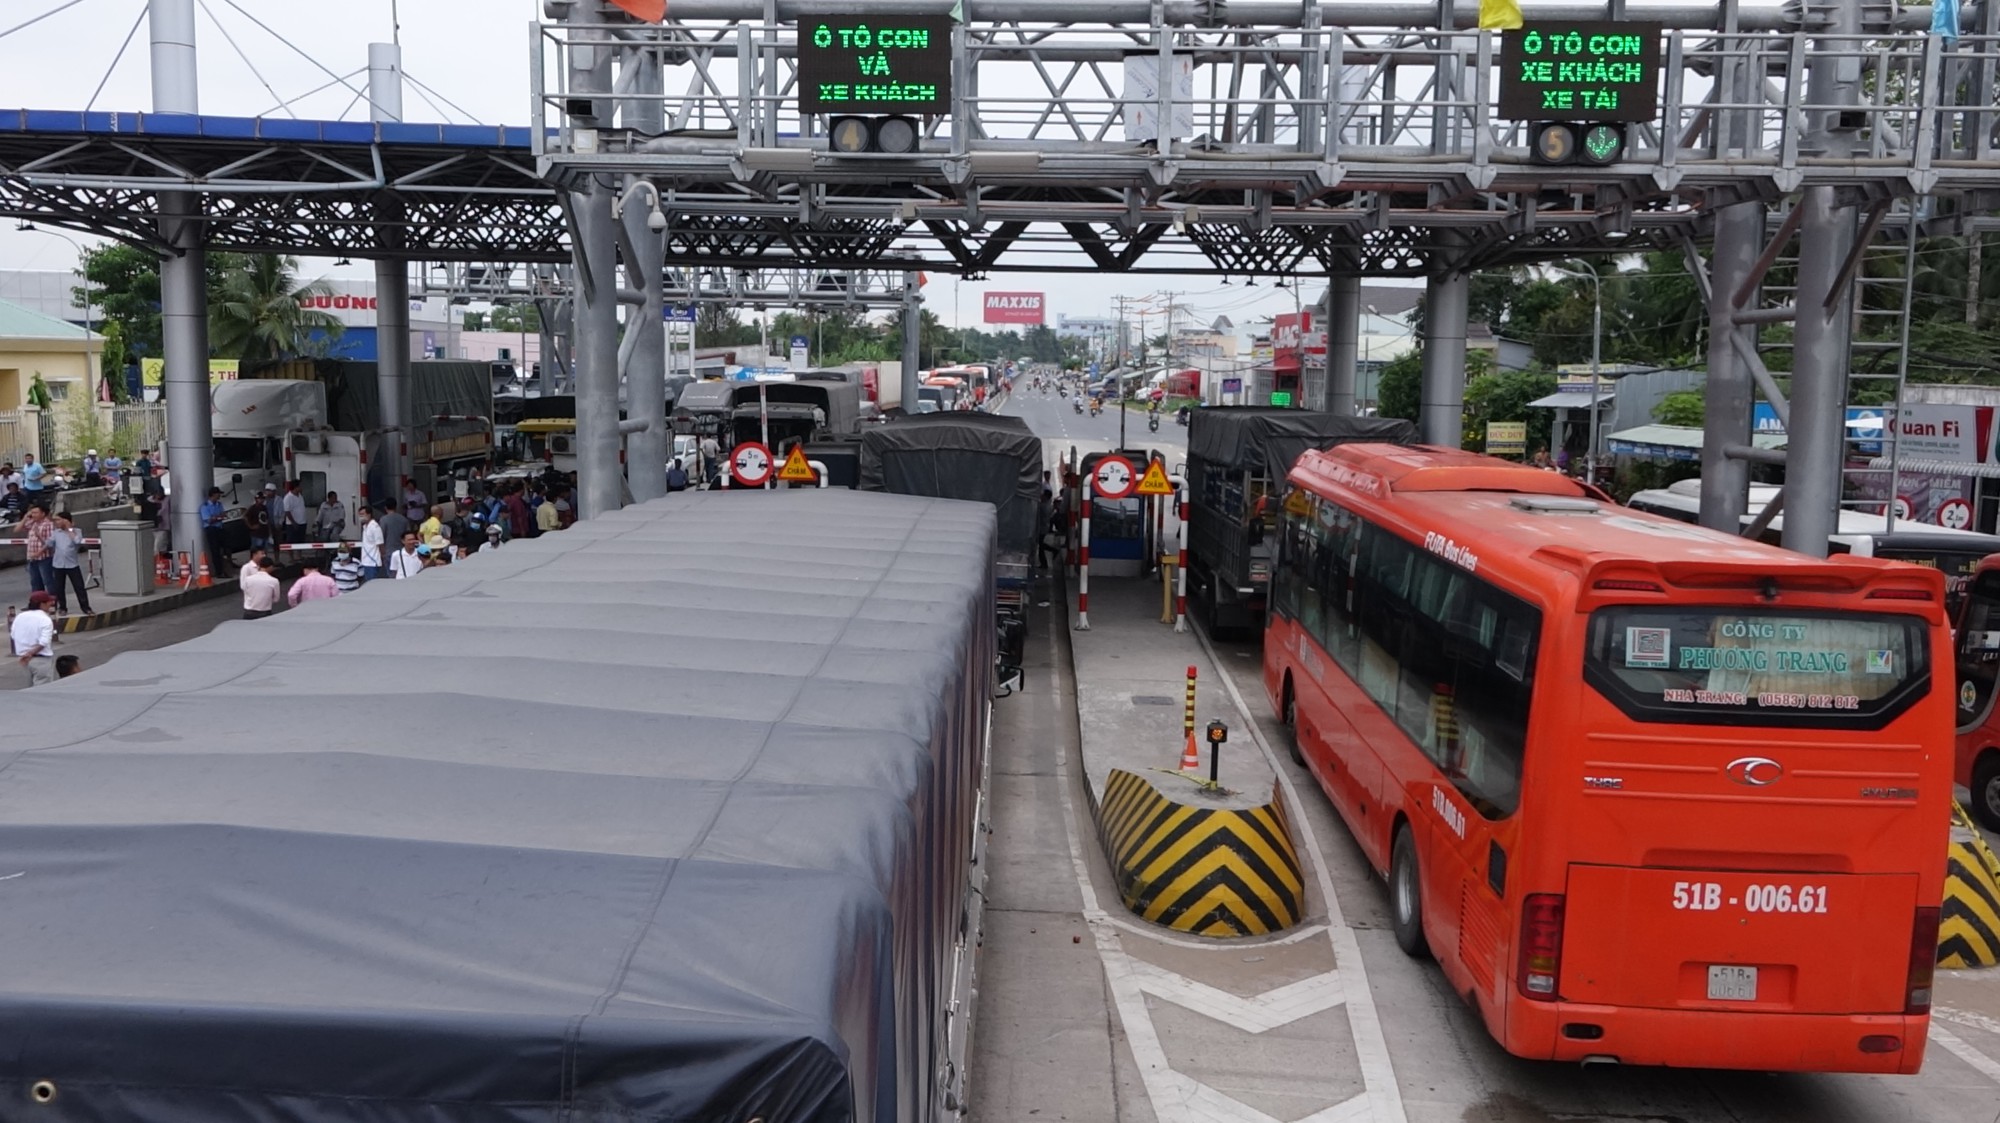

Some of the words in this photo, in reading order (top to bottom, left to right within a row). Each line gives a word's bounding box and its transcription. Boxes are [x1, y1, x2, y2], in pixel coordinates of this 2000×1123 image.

[814, 24, 832, 48] Ô
[838, 24, 871, 48] TÔ
[878, 30, 928, 48] CON
[1524, 31, 1542, 54] Ô
[1549, 31, 1582, 54] TÔ
[1589, 36, 1640, 54] CON
[858, 51, 890, 75] VÀ
[1521, 61, 1553, 82] XE
[1559, 58, 1641, 82] KHÁCH
[820, 84, 849, 100] XE
[855, 80, 935, 100] KHÁCH
[1542, 90, 1573, 109] XE
[842, 122, 859, 150] 4
[1546, 128, 1564, 158] 5
[986, 296, 1041, 309] MAXXIS
[1942, 420, 1960, 437] Fi
[1721, 620, 1775, 638] CÔNG
[1782, 625, 1806, 640] TY
[1775, 650, 1848, 674] TRANG
[1663, 688, 1695, 703] NHA
[1695, 690, 1747, 706] TRANG:
[1757, 692, 1807, 709] (0583)
[1807, 694, 1833, 709] 812
[1834, 695, 1860, 710] 812
[1672, 881, 1722, 911] 51B
[1744, 884, 1828, 913] 006.61
